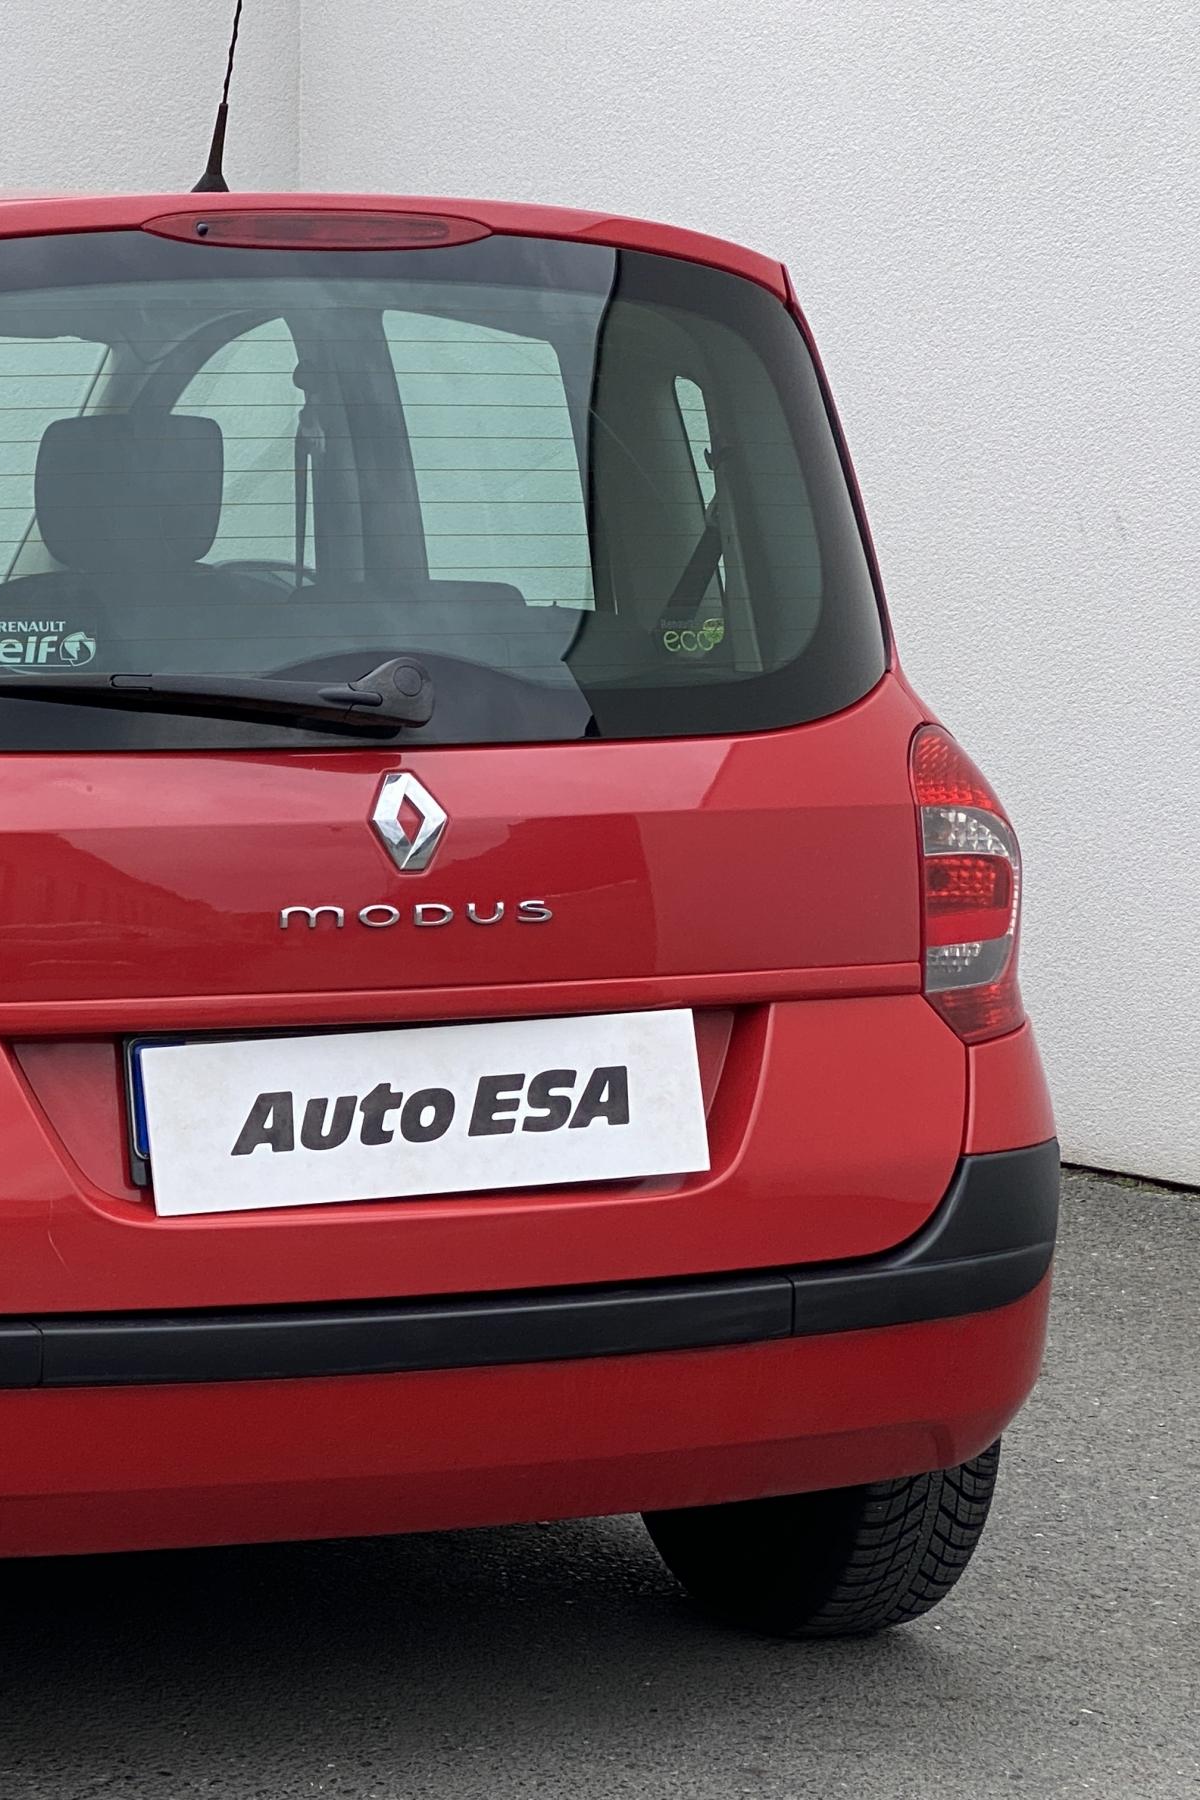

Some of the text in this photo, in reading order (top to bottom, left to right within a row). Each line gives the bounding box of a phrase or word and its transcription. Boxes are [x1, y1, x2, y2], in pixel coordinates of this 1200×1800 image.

[279, 900, 553, 929] MODUS
[230, 1065, 630, 1156] Auto ESA
